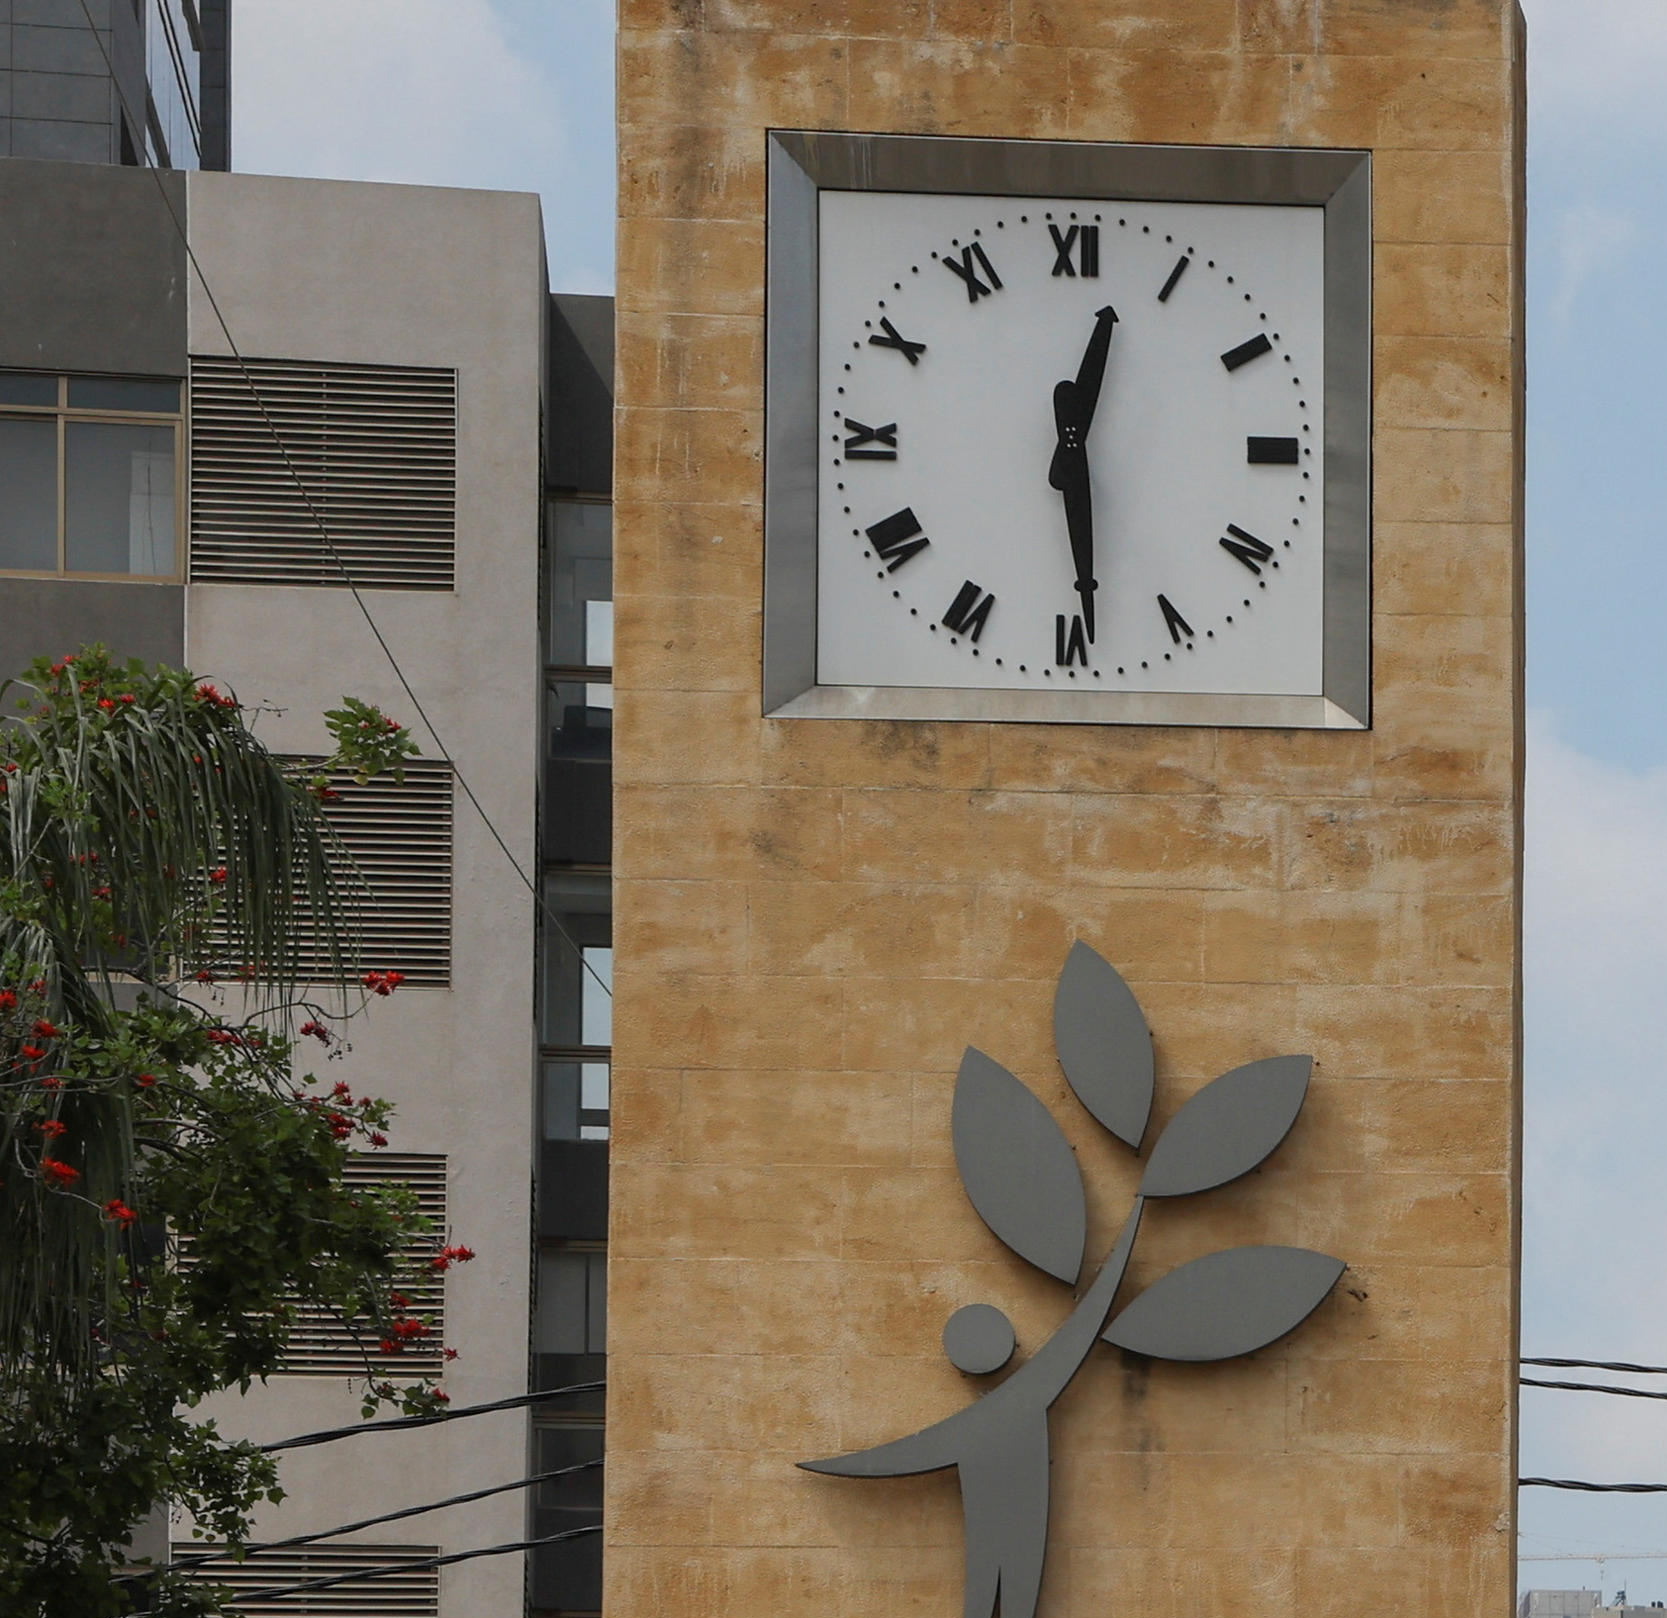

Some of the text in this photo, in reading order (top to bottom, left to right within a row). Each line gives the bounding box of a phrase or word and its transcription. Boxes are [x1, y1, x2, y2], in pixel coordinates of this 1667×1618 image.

[942, 241, 1003, 304] XI
[1048, 224, 1099, 278] XII
[868, 316, 927, 366] X
[844, 418, 897, 461] IX
[1219, 523, 1274, 575] IV
[941, 580, 996, 643] VII
[1156, 593, 1194, 645] V
[1055, 615, 1088, 667] VI
